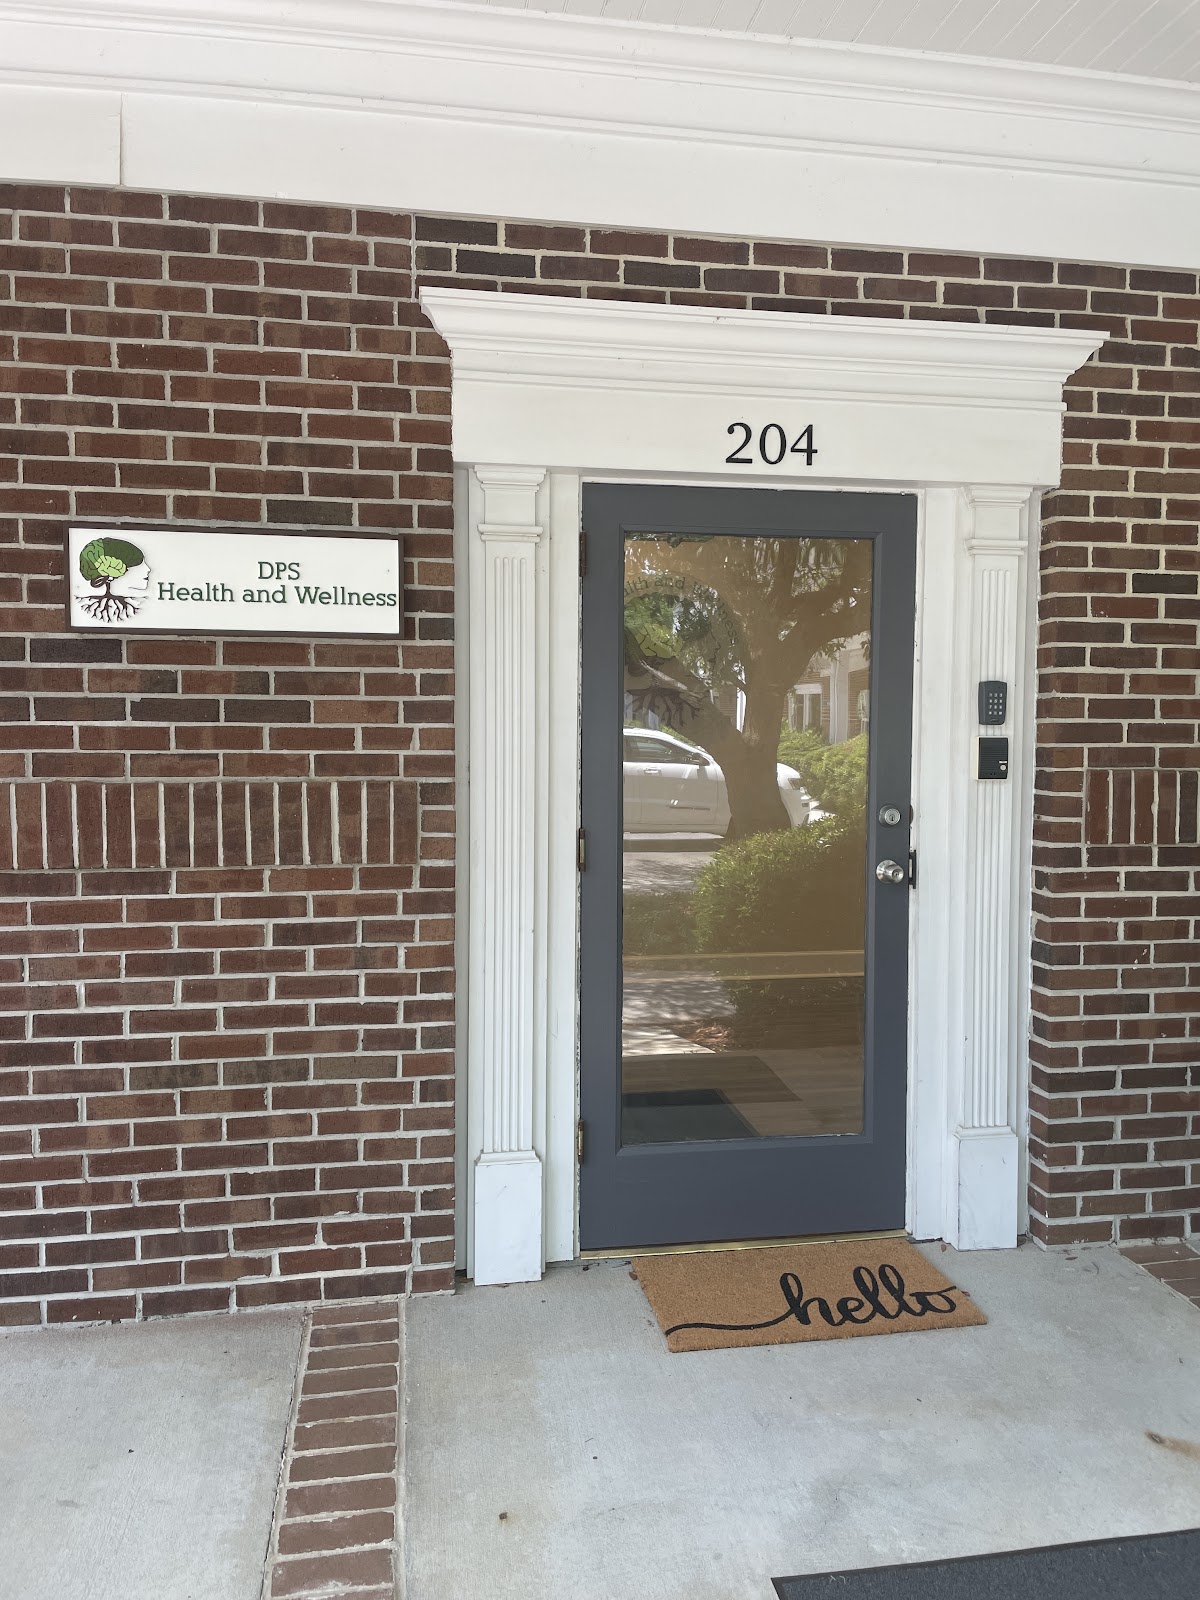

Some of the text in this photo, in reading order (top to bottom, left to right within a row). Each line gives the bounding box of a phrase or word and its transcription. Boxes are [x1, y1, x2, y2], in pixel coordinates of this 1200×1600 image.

[725, 422, 818, 466] 204
[257, 561, 301, 581] DPS
[654, 577, 685, 590] and
[157, 582, 397, 607] Health and Wellness
[665, 1263, 957, 1337] hello
